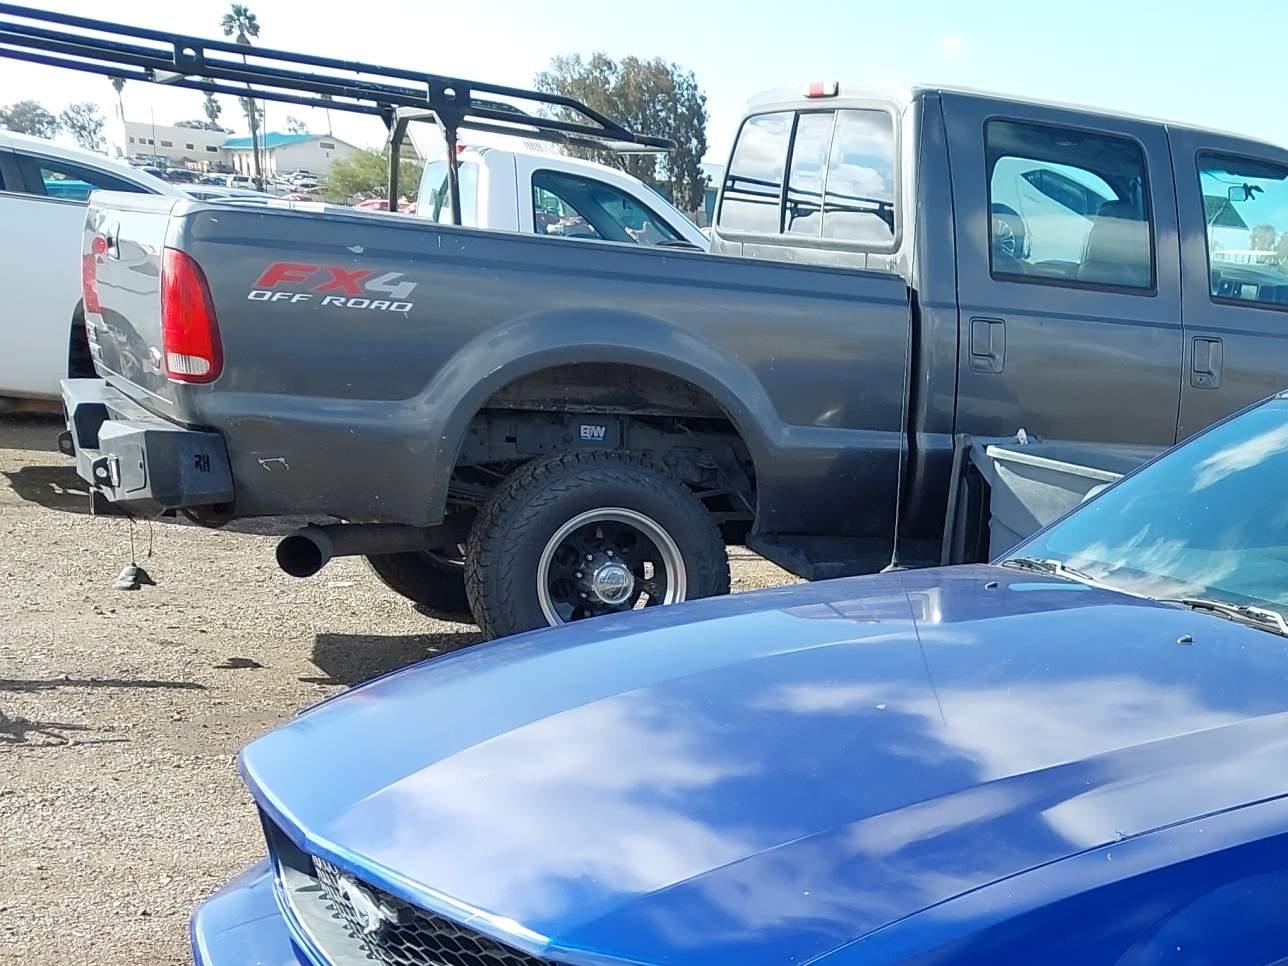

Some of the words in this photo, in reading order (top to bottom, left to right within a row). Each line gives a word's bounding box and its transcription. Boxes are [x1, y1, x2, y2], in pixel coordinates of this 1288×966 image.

[251, 262, 418, 299] FX4
[247, 290, 313, 304] OFF
[321, 296, 414, 313] ROAD
